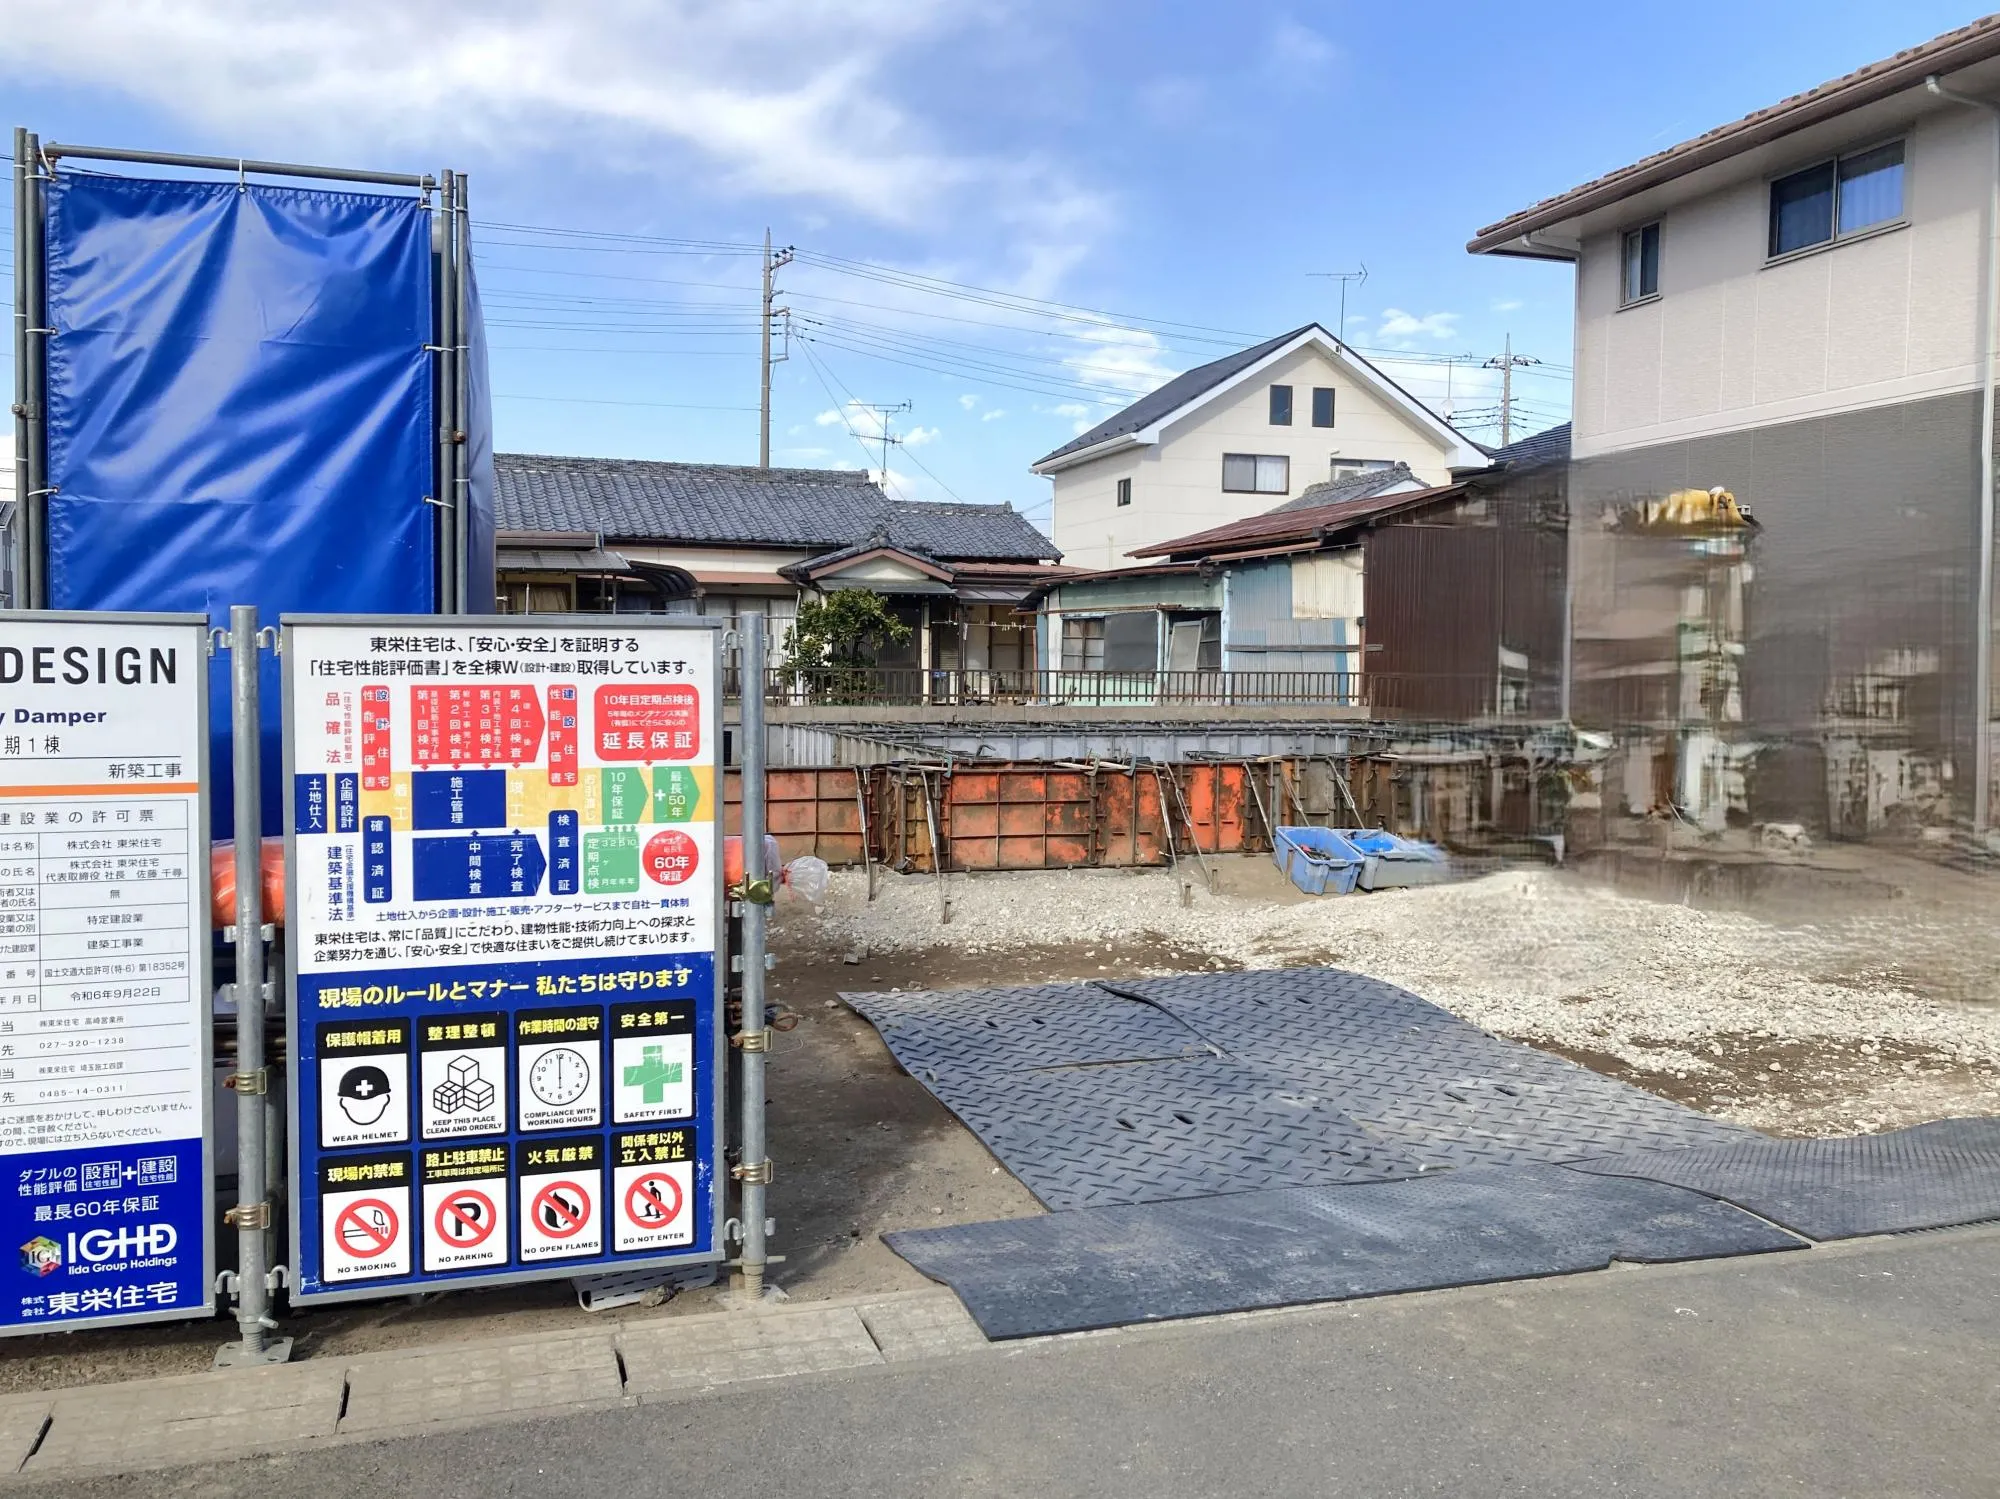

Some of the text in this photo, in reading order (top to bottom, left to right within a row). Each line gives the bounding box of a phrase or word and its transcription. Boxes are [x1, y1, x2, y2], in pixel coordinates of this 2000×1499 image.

[0, 646, 176, 685] DESIGN
[15, 708, 107, 726] Damper
[326, 692, 341, 764] 品確法
[602, 731, 693, 750] 延長保証
[108, 763, 182, 778] 新築工事
[308, 778, 322, 829] 土地仕入
[450, 776, 464, 824] 施工管理
[610, 772, 626, 820] 10年保証
[67, 838, 162, 850] 株式会社 東栄住宅
[371, 820, 384, 899] 確認済証
[557, 814, 570, 891] 検査済証
[70, 857, 159, 869] 株式会社 東栄住宅
[469, 842, 482, 894] 中間検査
[511, 840, 524, 892] 完了検査
[587, 838, 600, 889] 定期点検
[654, 855, 690, 870] 60年
[46, 871, 100, 882] 代表取締役
[105, 870, 125, 880] 社長
[136, 869, 157, 879] 佐藤
[660, 870, 683, 882] 保証
[327, 846, 344, 922] 建築基準法
[110, 889, 121, 899] 無
[87, 913, 144, 925] 特定建設業
[87, 938, 144, 949] 建築工事業
[70, 987, 161, 1001] 令和6年9月22日
[318, 967, 693, 1008] 現場のルールとマナー 私たちは守ります
[1, 1021, 14, 1032] 当
[519, 1016, 600, 1035] 作業時間の遵守
[620, 1011, 685, 1028] 安全第一
[326, 1029, 402, 1047] 保護帽着用
[427, 1022, 496, 1041] 整理整頓
[2, 1045, 14, 1056] 先
[40, 1037, 124, 1049] 027-320-1238
[3, 1092, 15, 1102] 先
[40, 1085, 123, 1098] 0485-14-0311
[524, 1107, 596, 1119] COMPLIANCE WITH
[527, 1115, 593, 1126] WORKING HOURS
[623, 1110, 656, 1118] SAFETY
[426, 1126, 450, 1134] CLEAN
[469, 1123, 502, 1132] ORDERLY
[432, 1118, 452, 1126] KEEP
[332, 1131, 398, 1142] WEAR HELMET
[621, 1131, 684, 1148] 関係者以外
[426, 1147, 505, 1167] 路上駐車禁止
[527, 1146, 593, 1165] 火気厳禁
[621, 1145, 685, 1163] 立入禁止
[19, 1166, 77, 1182] ダブルの
[85, 1164, 118, 1180] 設計
[142, 1159, 174, 1175] 建設
[327, 1162, 404, 1182] 現場内禁煙
[18, 1180, 77, 1197] 性能評価
[34, 1195, 160, 1222] 最長60年保証
[67, 1223, 178, 1264] IGHD
[637, 1235, 654, 1243] NOT
[657, 1232, 684, 1240] ENTER
[540, 1244, 562, 1252] OPEN
[565, 1241, 599, 1250] FLAMES
[93, 1262, 128, 1273] Group
[130, 1256, 178, 1268] Holdings
[454, 1252, 493, 1261] PARKING
[354, 1262, 397, 1272] SMOKING
[21, 1295, 45, 1305] 株式
[47, 1281, 178, 1315] 東栄住宅
[22, 1307, 45, 1317] 会社
